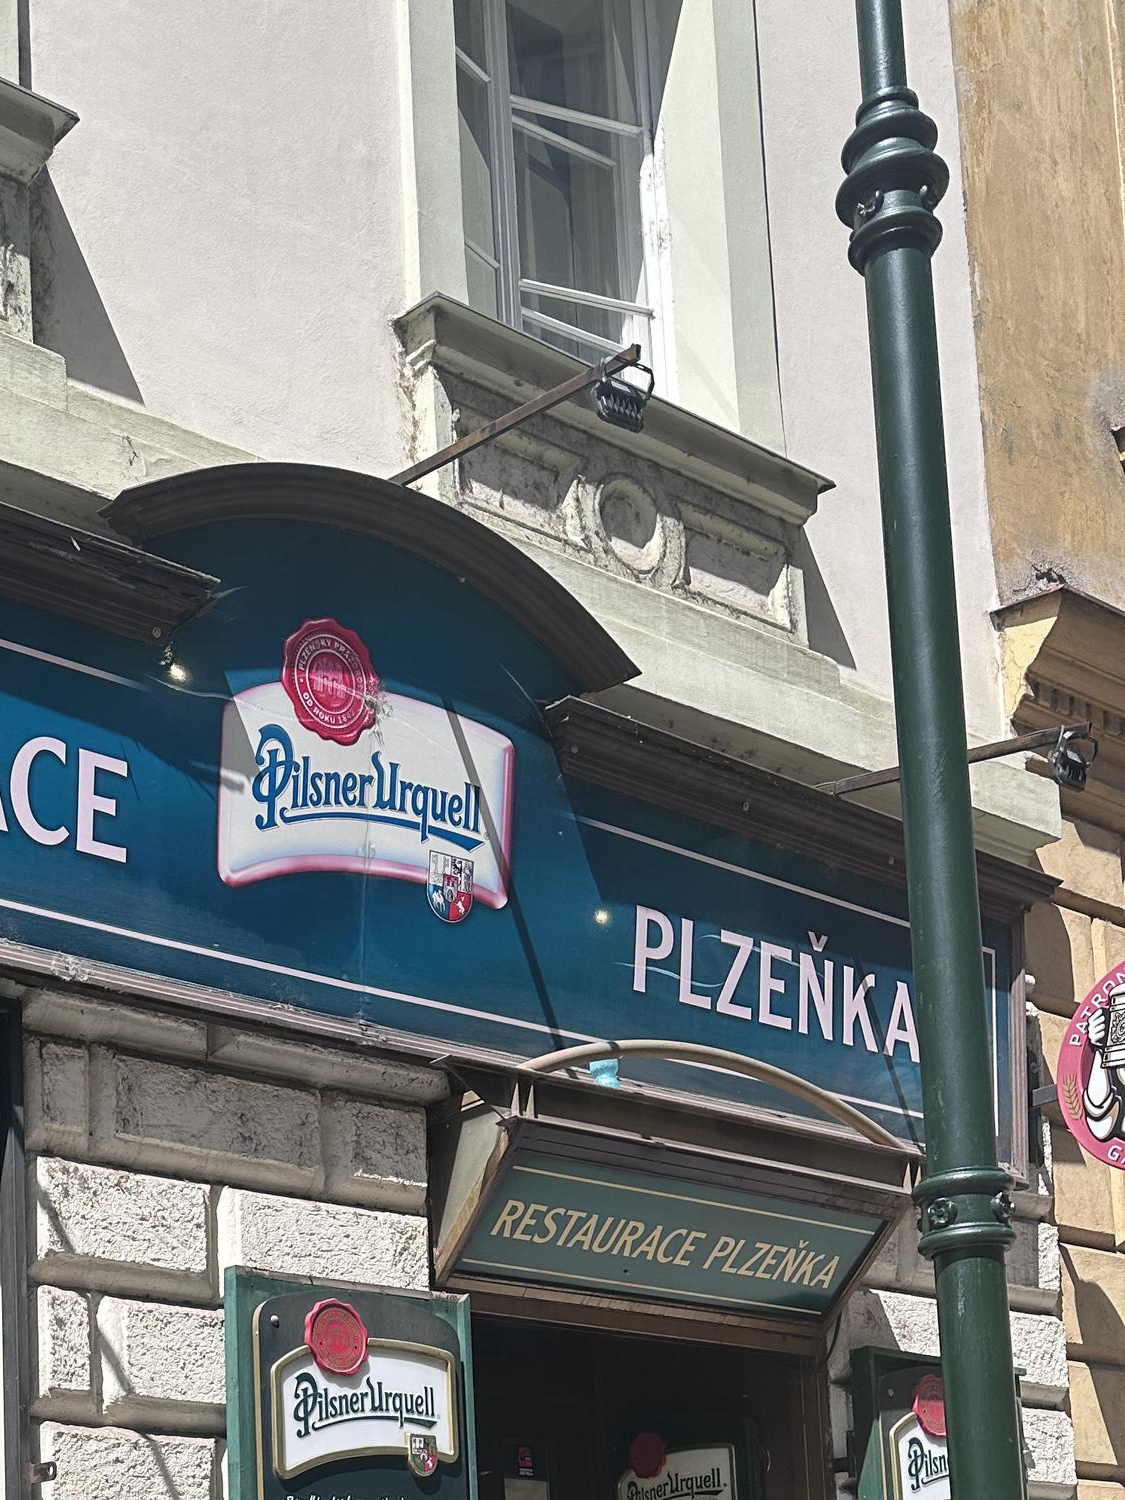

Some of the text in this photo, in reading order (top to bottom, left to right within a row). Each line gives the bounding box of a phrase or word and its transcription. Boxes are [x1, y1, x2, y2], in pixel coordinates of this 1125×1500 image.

[251, 723, 481, 844] Pilsner Urquell
[632, 903, 921, 1065] PLZEŇKA
[489, 1200, 841, 1289] RESTAURACE PLZEŇKA
[293, 1372, 436, 1439] Pilsner Urquell
[667, 1468, 722, 1499] Urquell
[907, 1436, 947, 1491] Pilsn
